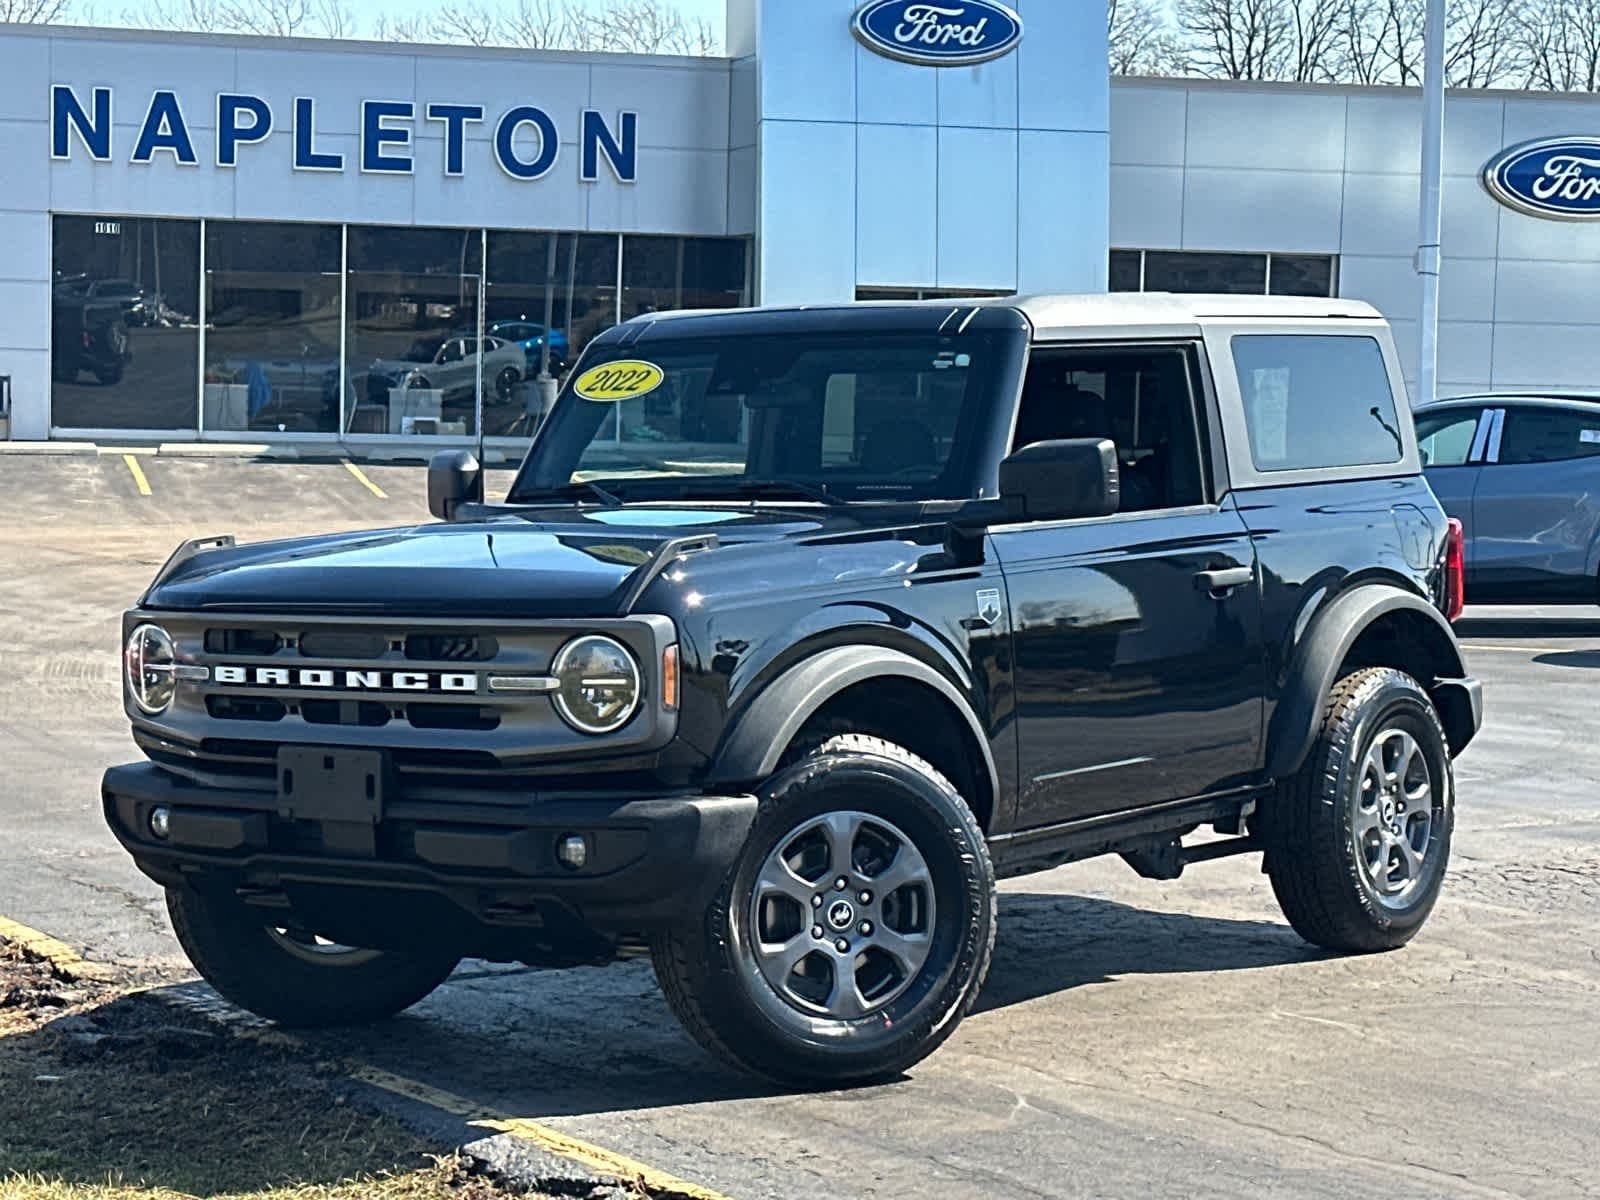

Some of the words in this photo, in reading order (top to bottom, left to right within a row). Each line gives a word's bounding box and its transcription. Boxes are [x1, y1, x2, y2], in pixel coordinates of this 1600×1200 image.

[894, 4, 989, 46] Ford
[50, 83, 639, 184] NAPLETON
[1532, 155, 1600, 200] For
[583, 369, 652, 392] 2022
[214, 665, 479, 691] BRONCO
